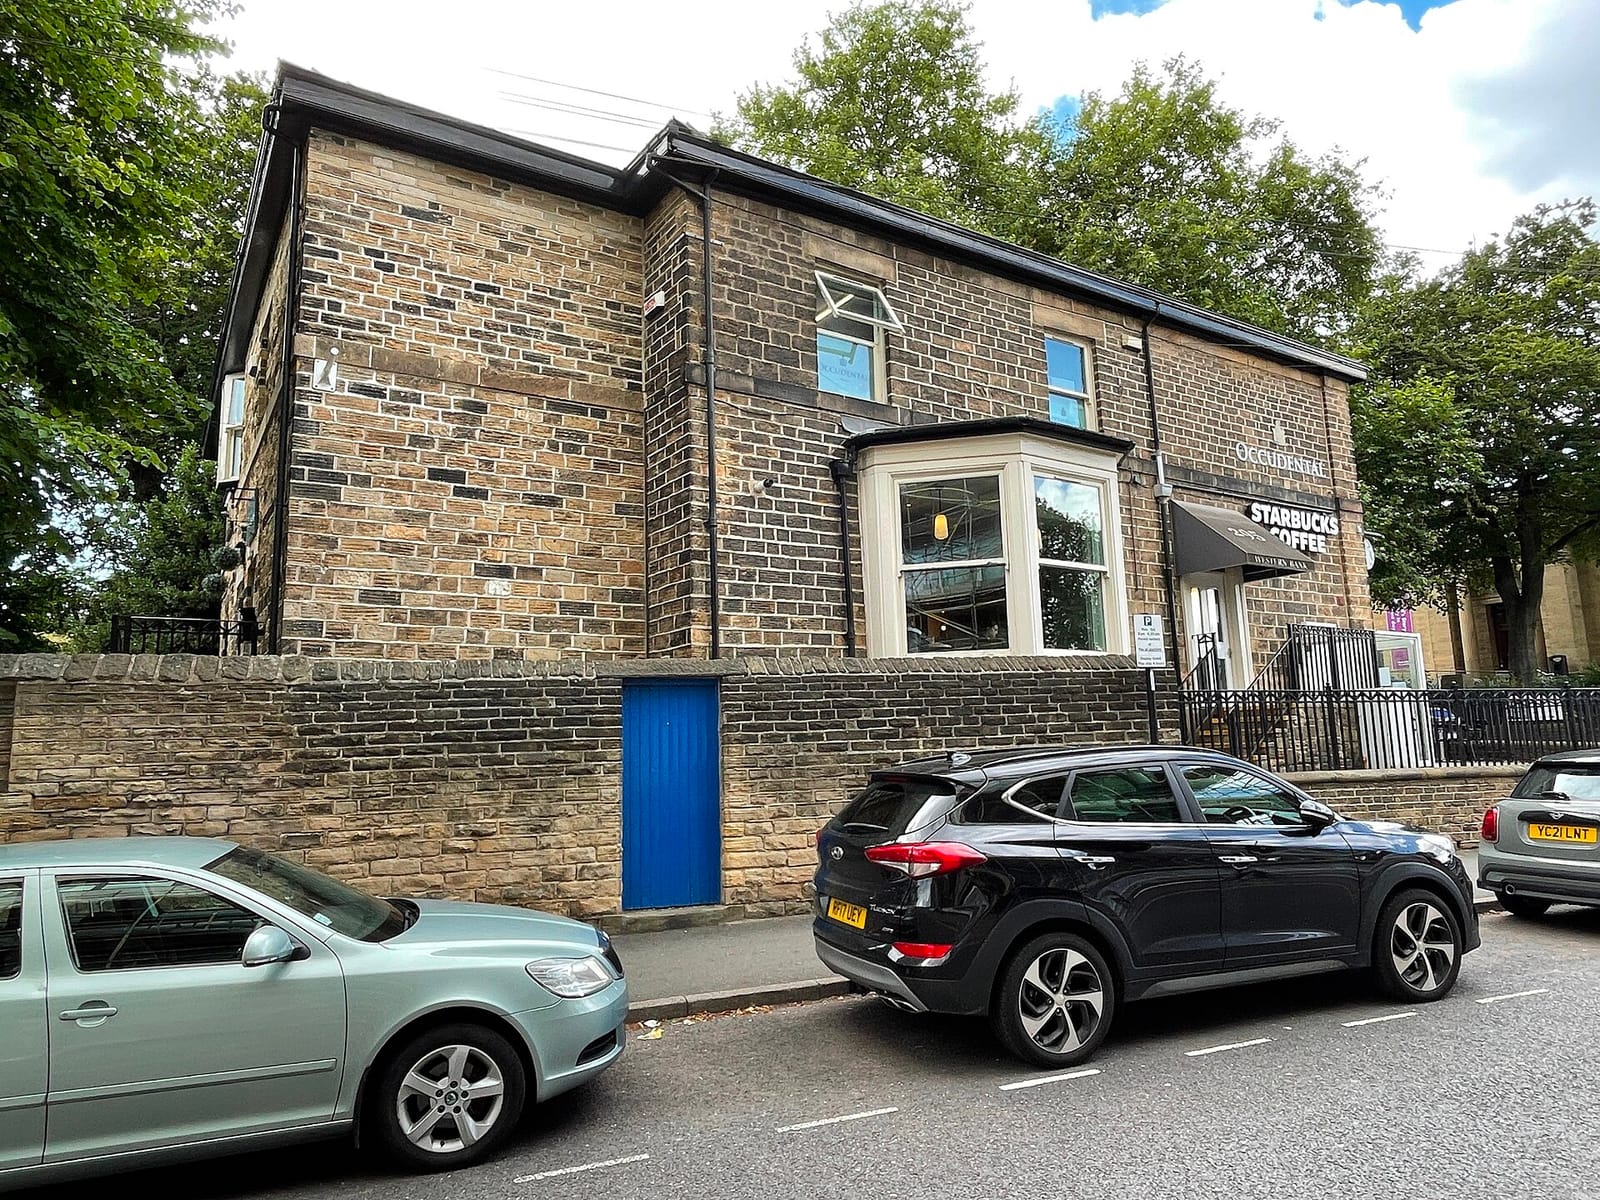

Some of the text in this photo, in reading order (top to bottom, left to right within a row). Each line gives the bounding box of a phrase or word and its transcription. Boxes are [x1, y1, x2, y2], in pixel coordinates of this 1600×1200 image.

[1251, 502, 1339, 536] STARBUCKS
[1144, 616, 1152, 626] P
[1537, 825, 1589, 840] YC21 LNT
